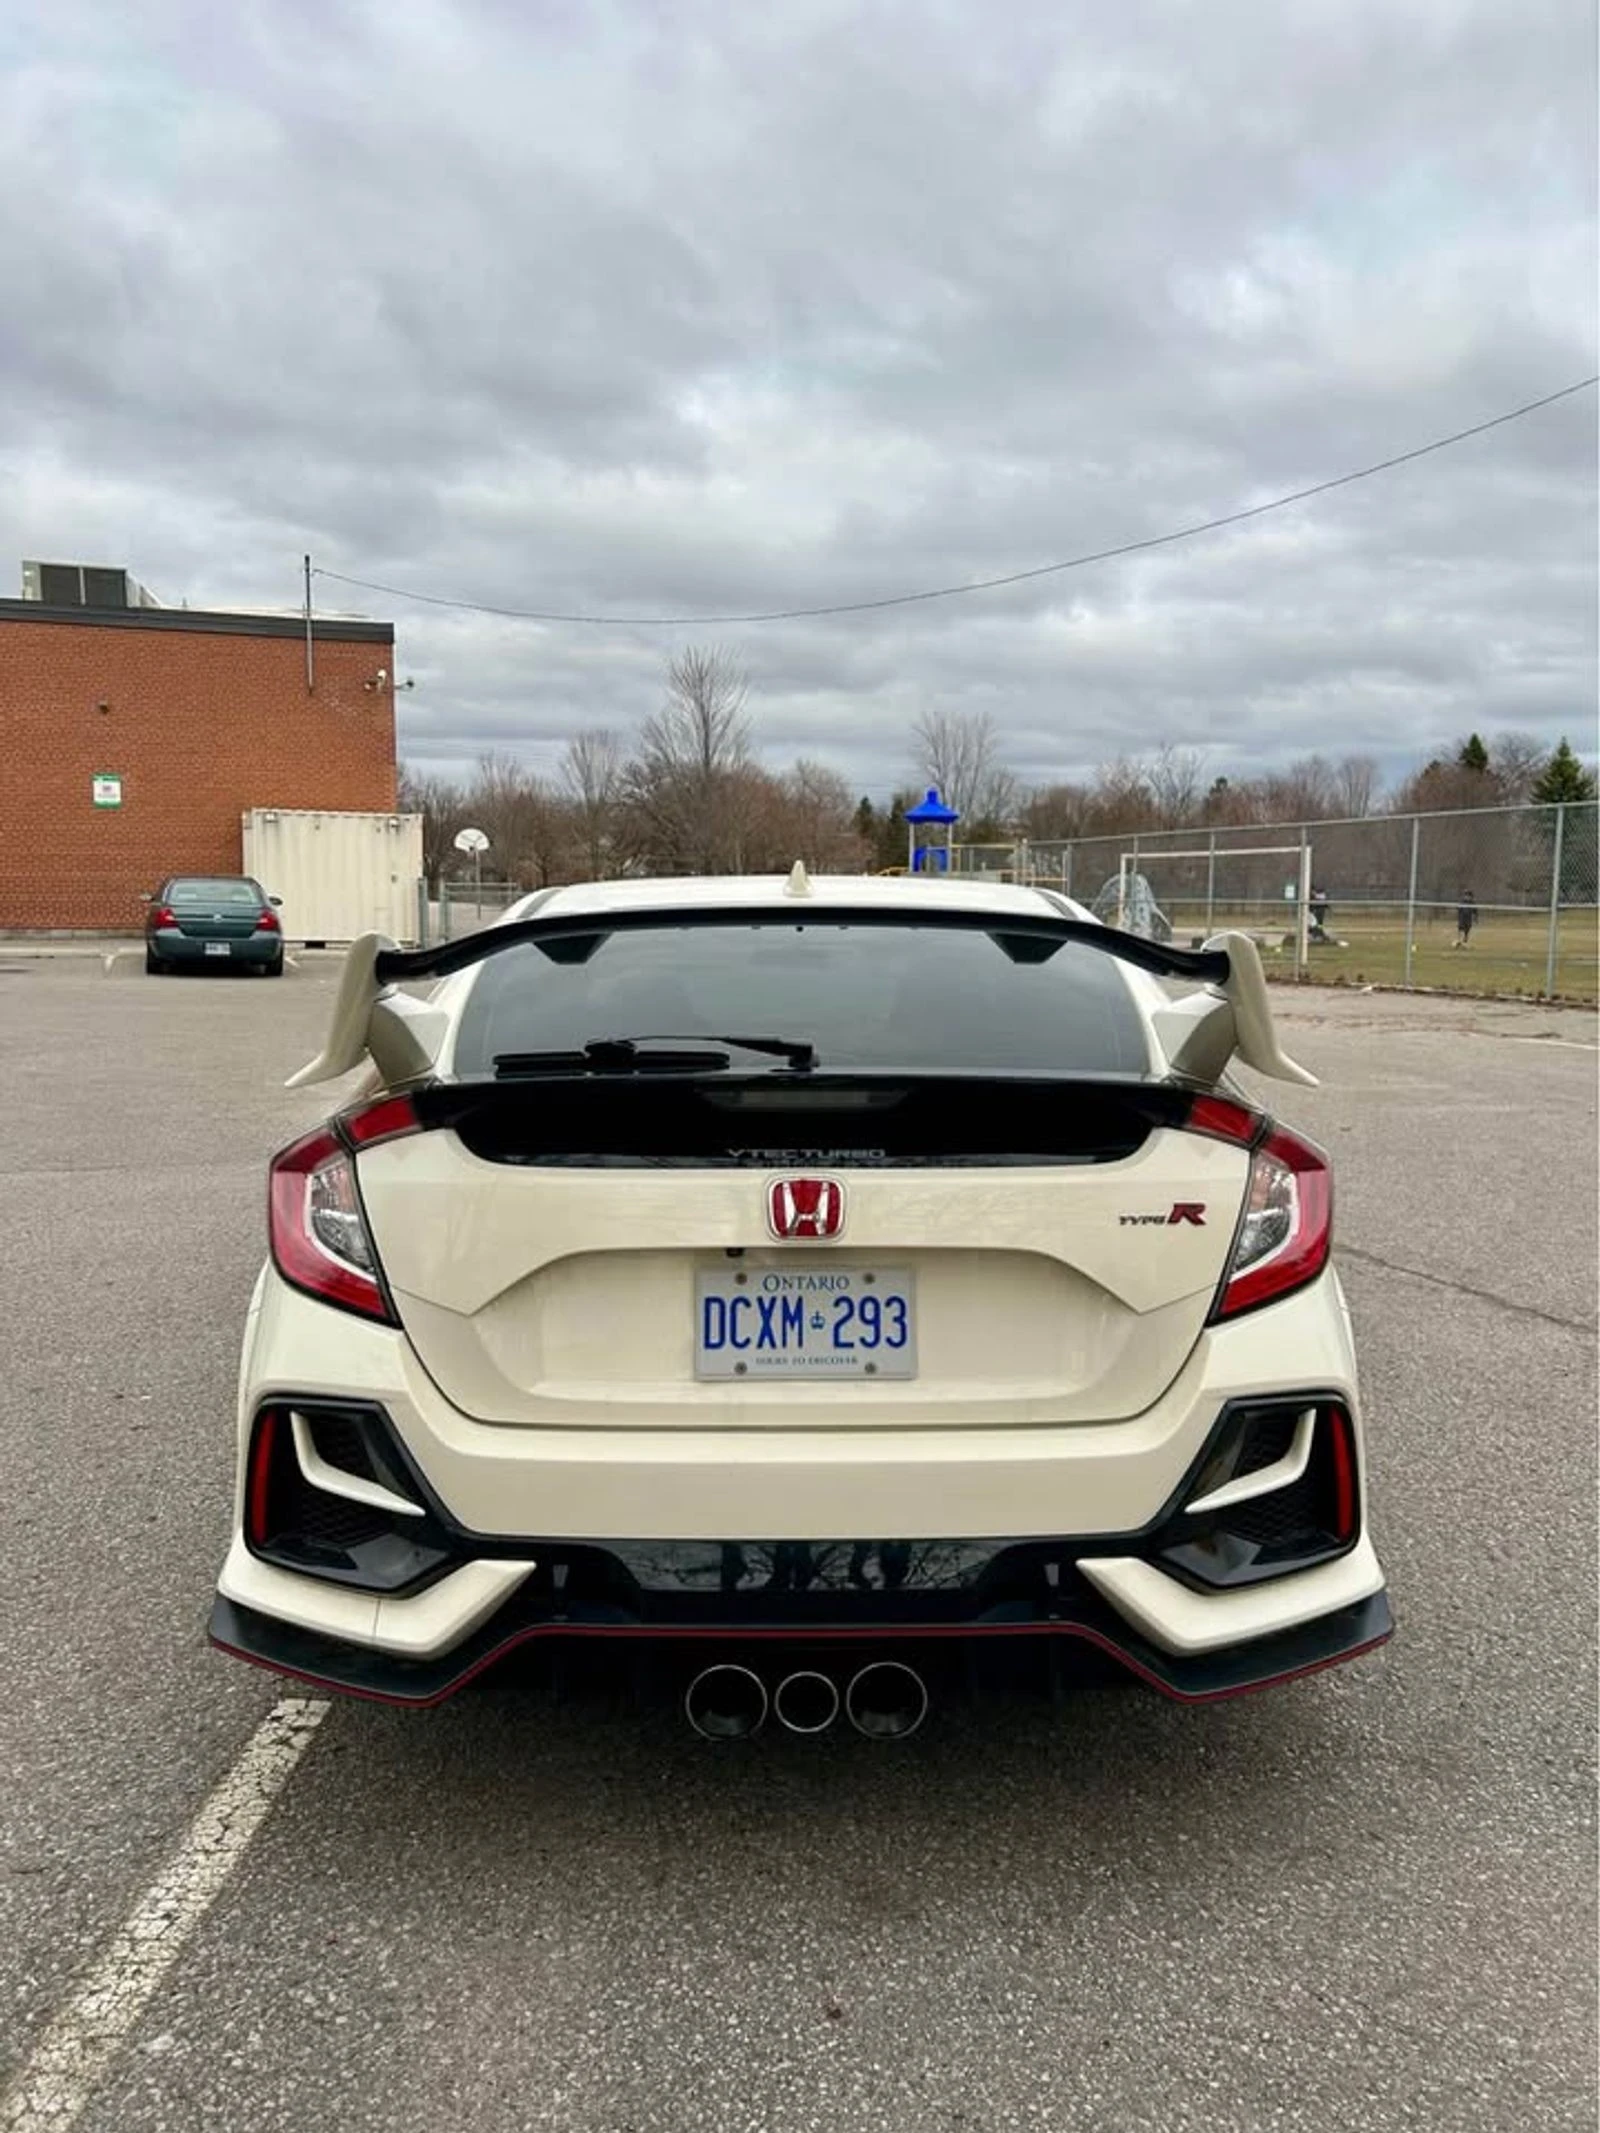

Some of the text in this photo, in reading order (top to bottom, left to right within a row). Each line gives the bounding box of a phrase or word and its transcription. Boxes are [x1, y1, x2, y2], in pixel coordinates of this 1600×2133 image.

[1167, 1202, 1206, 1226] R
[763, 1273, 850, 1292] ONTARIO
[703, 1296, 907, 1350] DCXM 293
